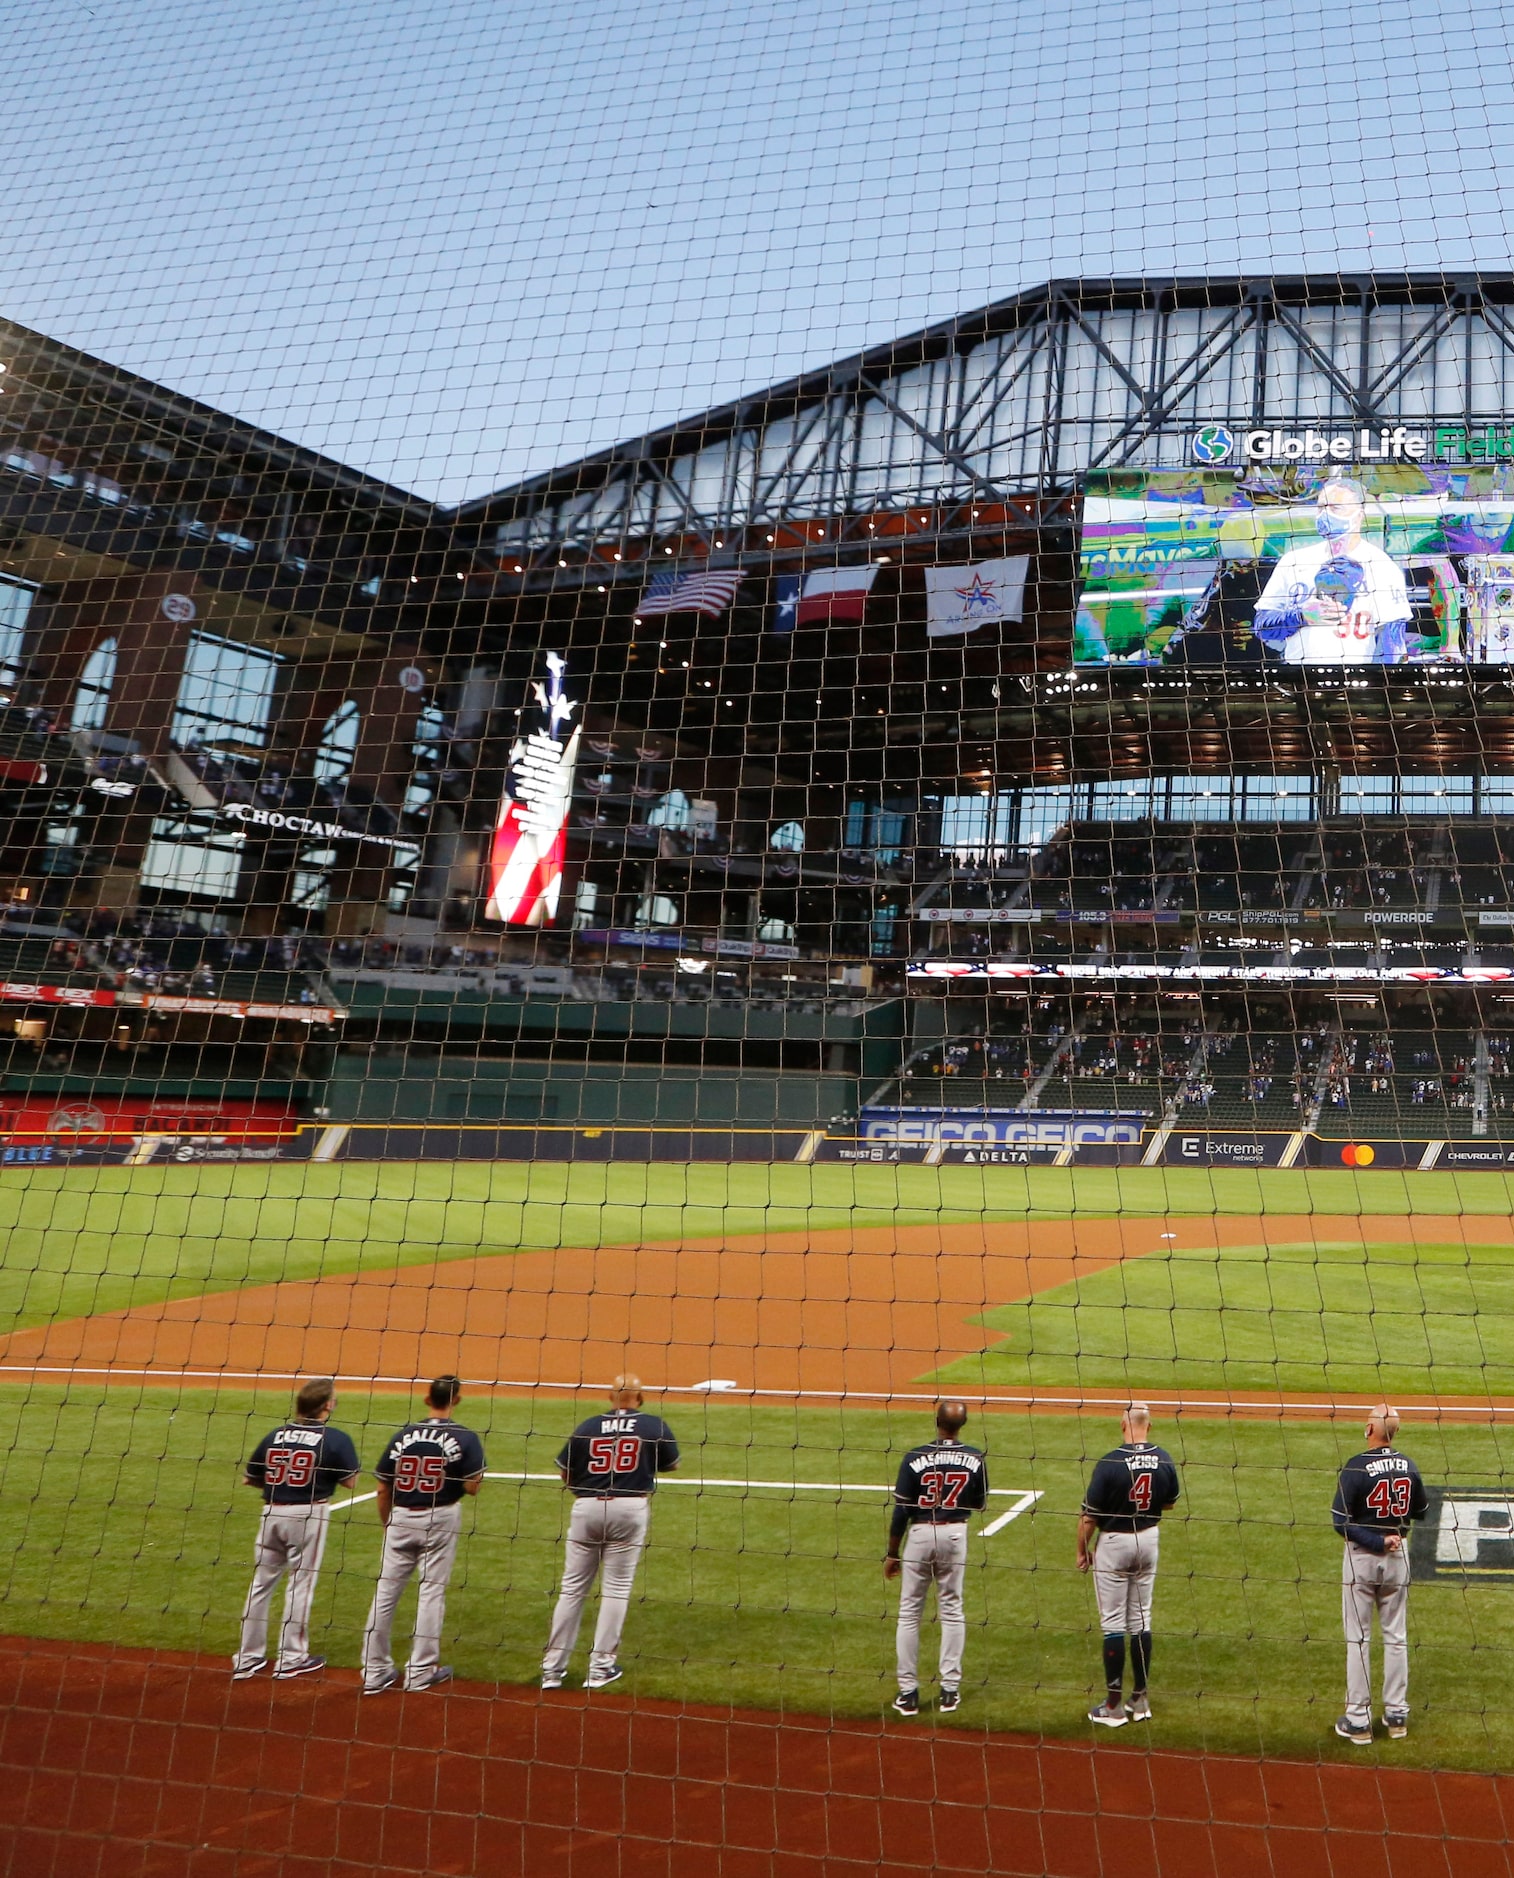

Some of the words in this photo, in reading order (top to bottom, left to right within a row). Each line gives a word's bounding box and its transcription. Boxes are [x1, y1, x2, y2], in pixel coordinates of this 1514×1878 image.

[1244, 429, 1351, 460] Globe
[1360, 427, 1427, 458] Life
[237, 803, 343, 838] CHOCTAW
[1078, 911, 1107, 921] 105.3
[1208, 911, 1236, 920] PGL
[1364, 912, 1434, 923] POWERADE
[54, 986, 96, 999] DEX
[866, 1121, 996, 1150] GEICO
[1005, 1122, 1139, 1152] GEICO
[979, 1151, 1028, 1163] DELTA
[1205, 1141, 1265, 1155] Extreme
[1447, 1152, 1504, 1160] CHEVROLET
[601, 1418, 638, 1434] HALE
[272, 1429, 324, 1447] CASTRO
[388, 1428, 463, 1463] MAGALLANES
[588, 1436, 642, 1474] 58
[908, 1450, 982, 1474] WASHINGTON
[1124, 1454, 1160, 1471] WEISS
[264, 1448, 317, 1487] 59
[394, 1455, 448, 1494] 95
[1365, 1458, 1409, 1478] SNITKER
[917, 1471, 970, 1510] 37
[1128, 1472, 1153, 1511] 4
[1366, 1477, 1412, 1518] 43
